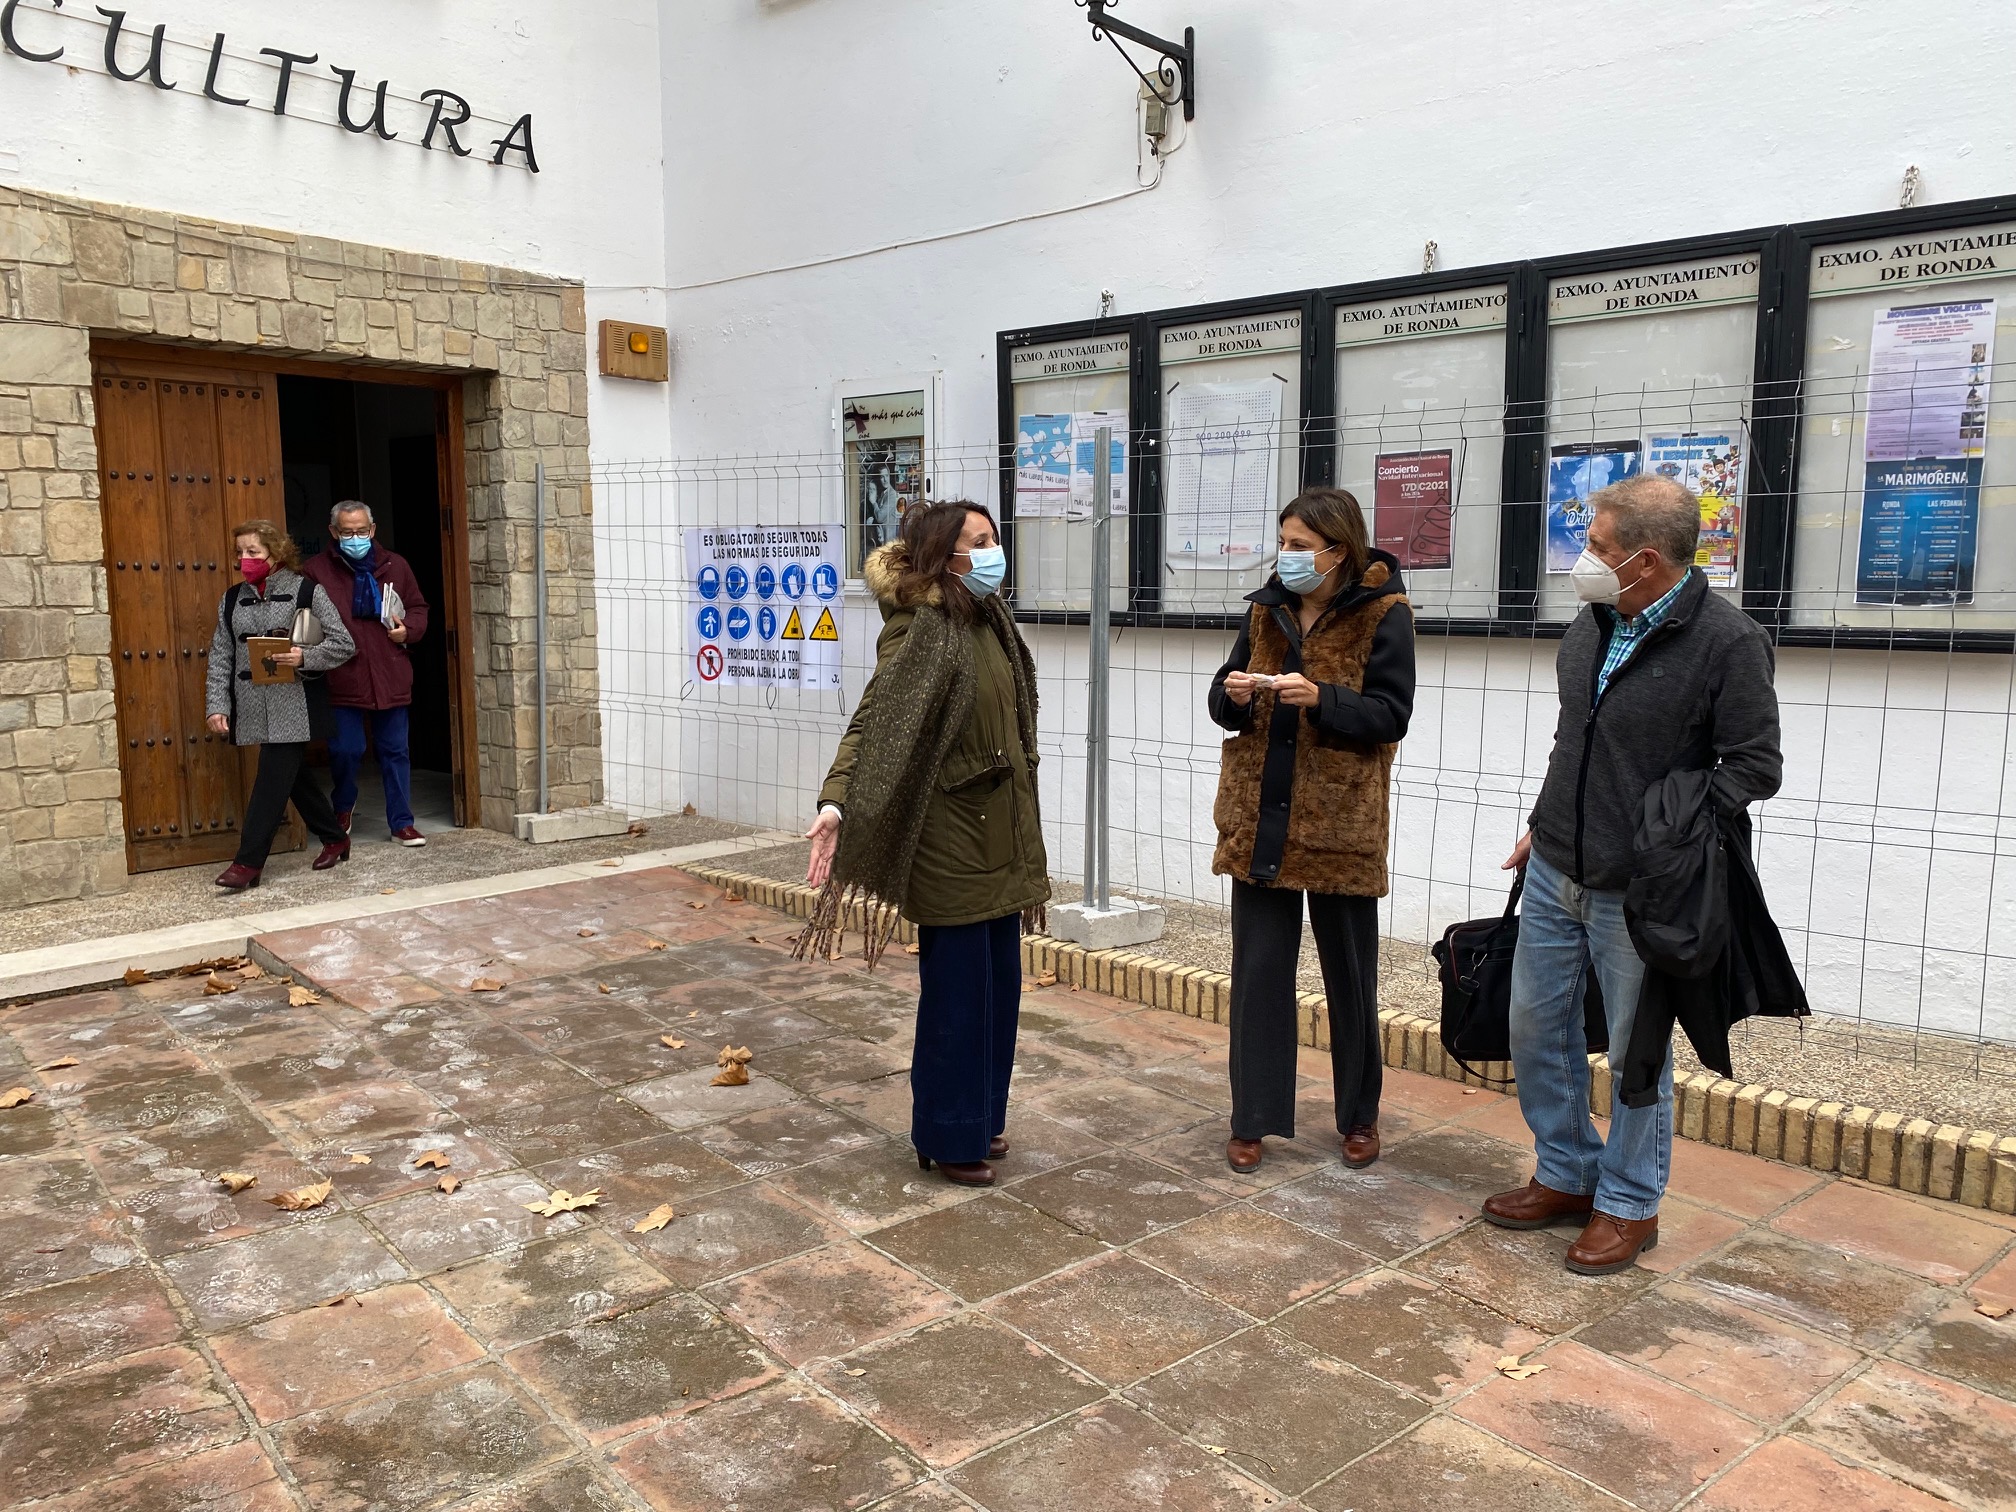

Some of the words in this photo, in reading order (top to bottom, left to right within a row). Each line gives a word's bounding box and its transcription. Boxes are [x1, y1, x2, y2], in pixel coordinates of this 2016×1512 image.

[0, 0, 540, 174] CULTURA
[1818, 249, 1883, 269] EXMO.
[1880, 266, 1909, 282] DE
[1916, 255, 1998, 277] RONDA
[1555, 281, 1608, 299] EXMO.
[1612, 260, 1757, 292] AYUNTAMIENTO
[1605, 296, 1630, 311] DE
[1634, 288, 1700, 307] RONDA
[1342, 308, 1386, 324] EXMO.
[1389, 294, 1507, 318] AYUNTAMIENTO
[1163, 330, 1200, 344] EXMO.
[1203, 317, 1300, 339] AYUNTAMIENTO
[1383, 322, 1403, 335] DE
[1407, 317, 1460, 332] RONDA
[1014, 351, 1045, 364] EXMO.
[1047, 341, 1129, 360] AYUNTAMIENTO
[1198, 343, 1215, 355] DE
[1218, 338, 1263, 352] RONDA
[1043, 364, 1058, 375] DE
[1060, 359, 1097, 372] RONDA
[870, 409, 888, 420] más
[890, 409, 904, 424] que
[905, 406, 924, 418] cine
[1215, 431, 1231, 439] 200
[1378, 465, 1419, 475] Concierto
[1885, 470, 1969, 486] MARIMORENA
[1400, 480, 1449, 492] 17DC2021
[703, 535, 713, 547] ES
[715, 532, 765, 546] OBLIGATORIO
[766, 531, 799, 544] SEGUIR
[799, 530, 828, 543] TODAS
[713, 547, 725, 560] LAS
[726, 546, 759, 559] NORMAS
[761, 546, 770, 558] DE
[772, 545, 821, 558] SEGURIDAD
[727, 647, 759, 661] PROHIBIDO
[781, 650, 787, 662] A
[727, 665, 755, 678] PERSONA
[778, 668, 786, 680] LA
